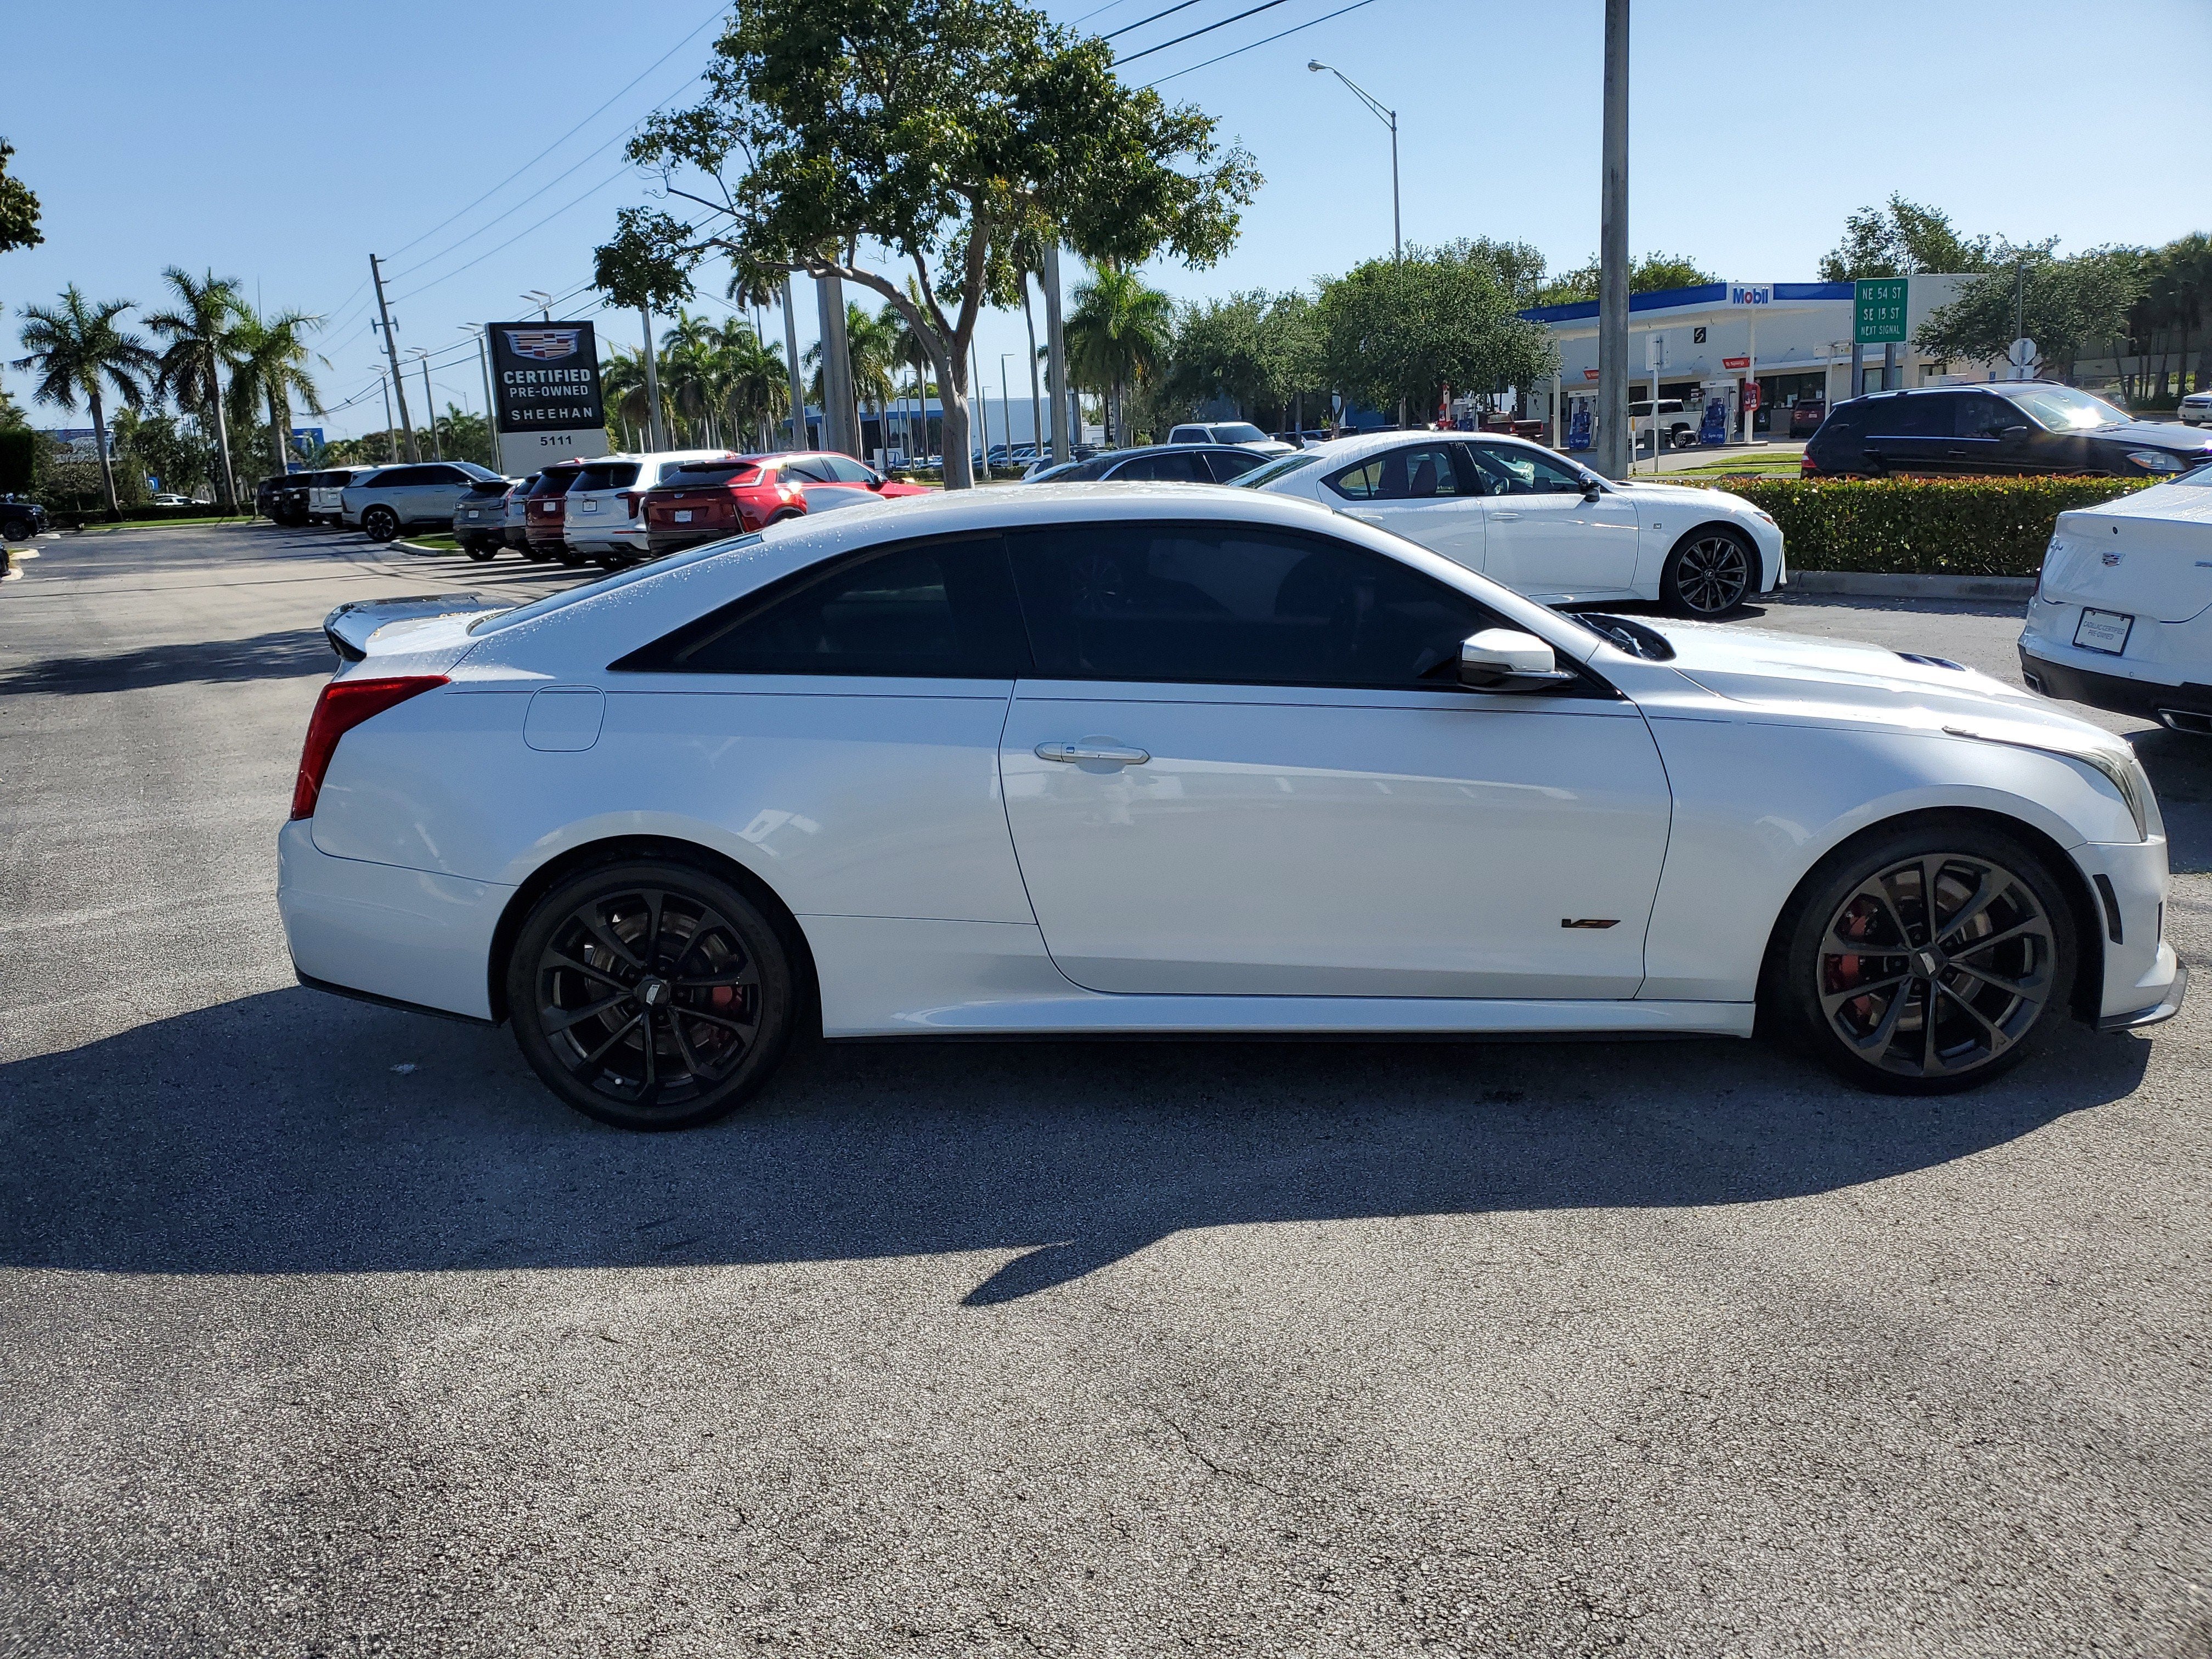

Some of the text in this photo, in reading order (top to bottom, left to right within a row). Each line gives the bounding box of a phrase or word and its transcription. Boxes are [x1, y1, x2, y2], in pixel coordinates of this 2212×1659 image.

[1733, 286, 1769, 304] Mobil
[1863, 287, 1901, 300] NE 54 ST
[1864, 307, 1899, 321] SE 15 ST
[1861, 325, 1900, 336] NEXT SIGNAL
[503, 369, 590, 384] CERTIFIED
[510, 385, 588, 398] PRE-OWNED
[512, 407, 592, 421] SHEEHAN
[540, 435, 572, 446] 5111
[2084, 621, 2125, 635] CADILLAC CERTIFIED
